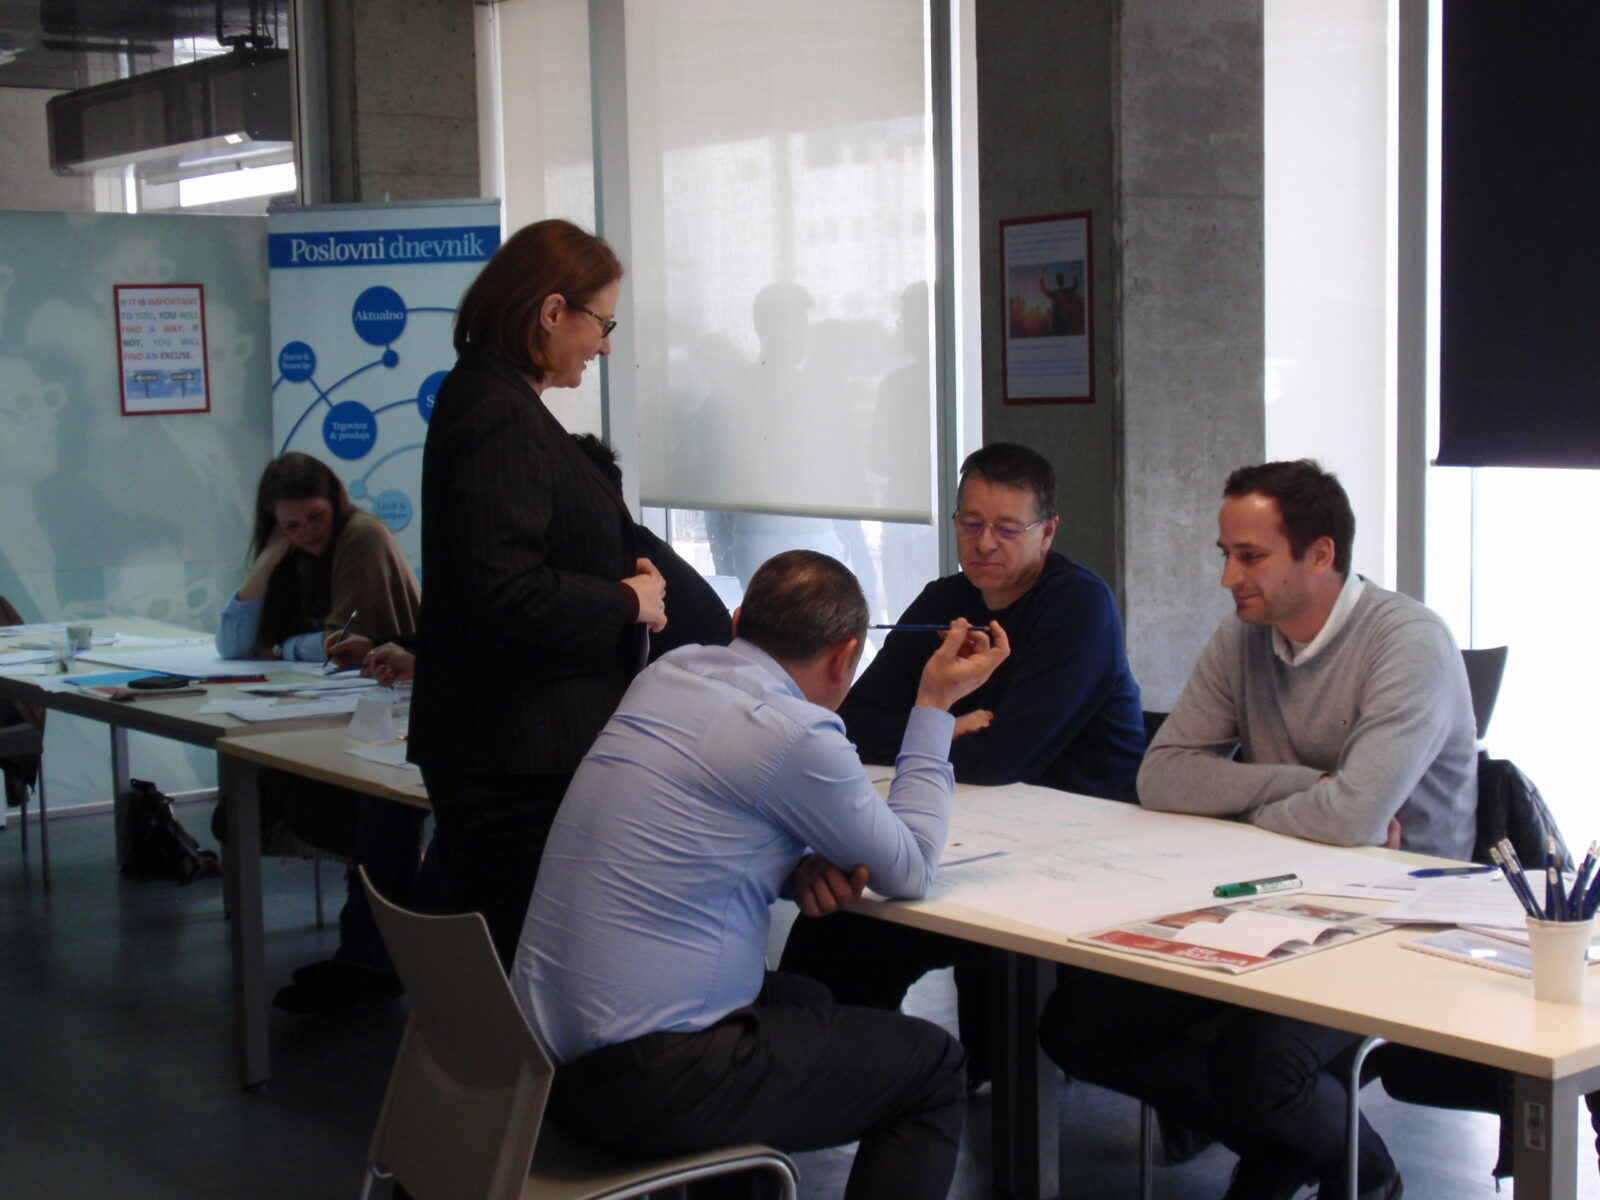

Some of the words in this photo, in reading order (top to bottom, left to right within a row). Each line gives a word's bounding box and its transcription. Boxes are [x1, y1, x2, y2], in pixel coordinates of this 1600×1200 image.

[290, 237, 385, 262] Poslovni
[389, 233, 486, 259] dnevnik
[138, 298, 146, 306] IS
[147, 298, 197, 306] IMPORTANT
[121, 312, 133, 320] TO
[159, 312, 177, 320] YOU
[180, 311, 199, 319] WILL
[354, 310, 404, 322] Aktualno
[121, 325, 142, 333] FIND
[149, 325, 156, 333] A
[153, 338, 172, 346] YOU
[180, 338, 200, 346] WILL
[122, 352, 144, 361] FIND
[145, 352, 159, 360] AN
[332, 422, 368, 431] Trgovina
[329, 431, 337, 440] &
[338, 431, 370, 441] prodaja
